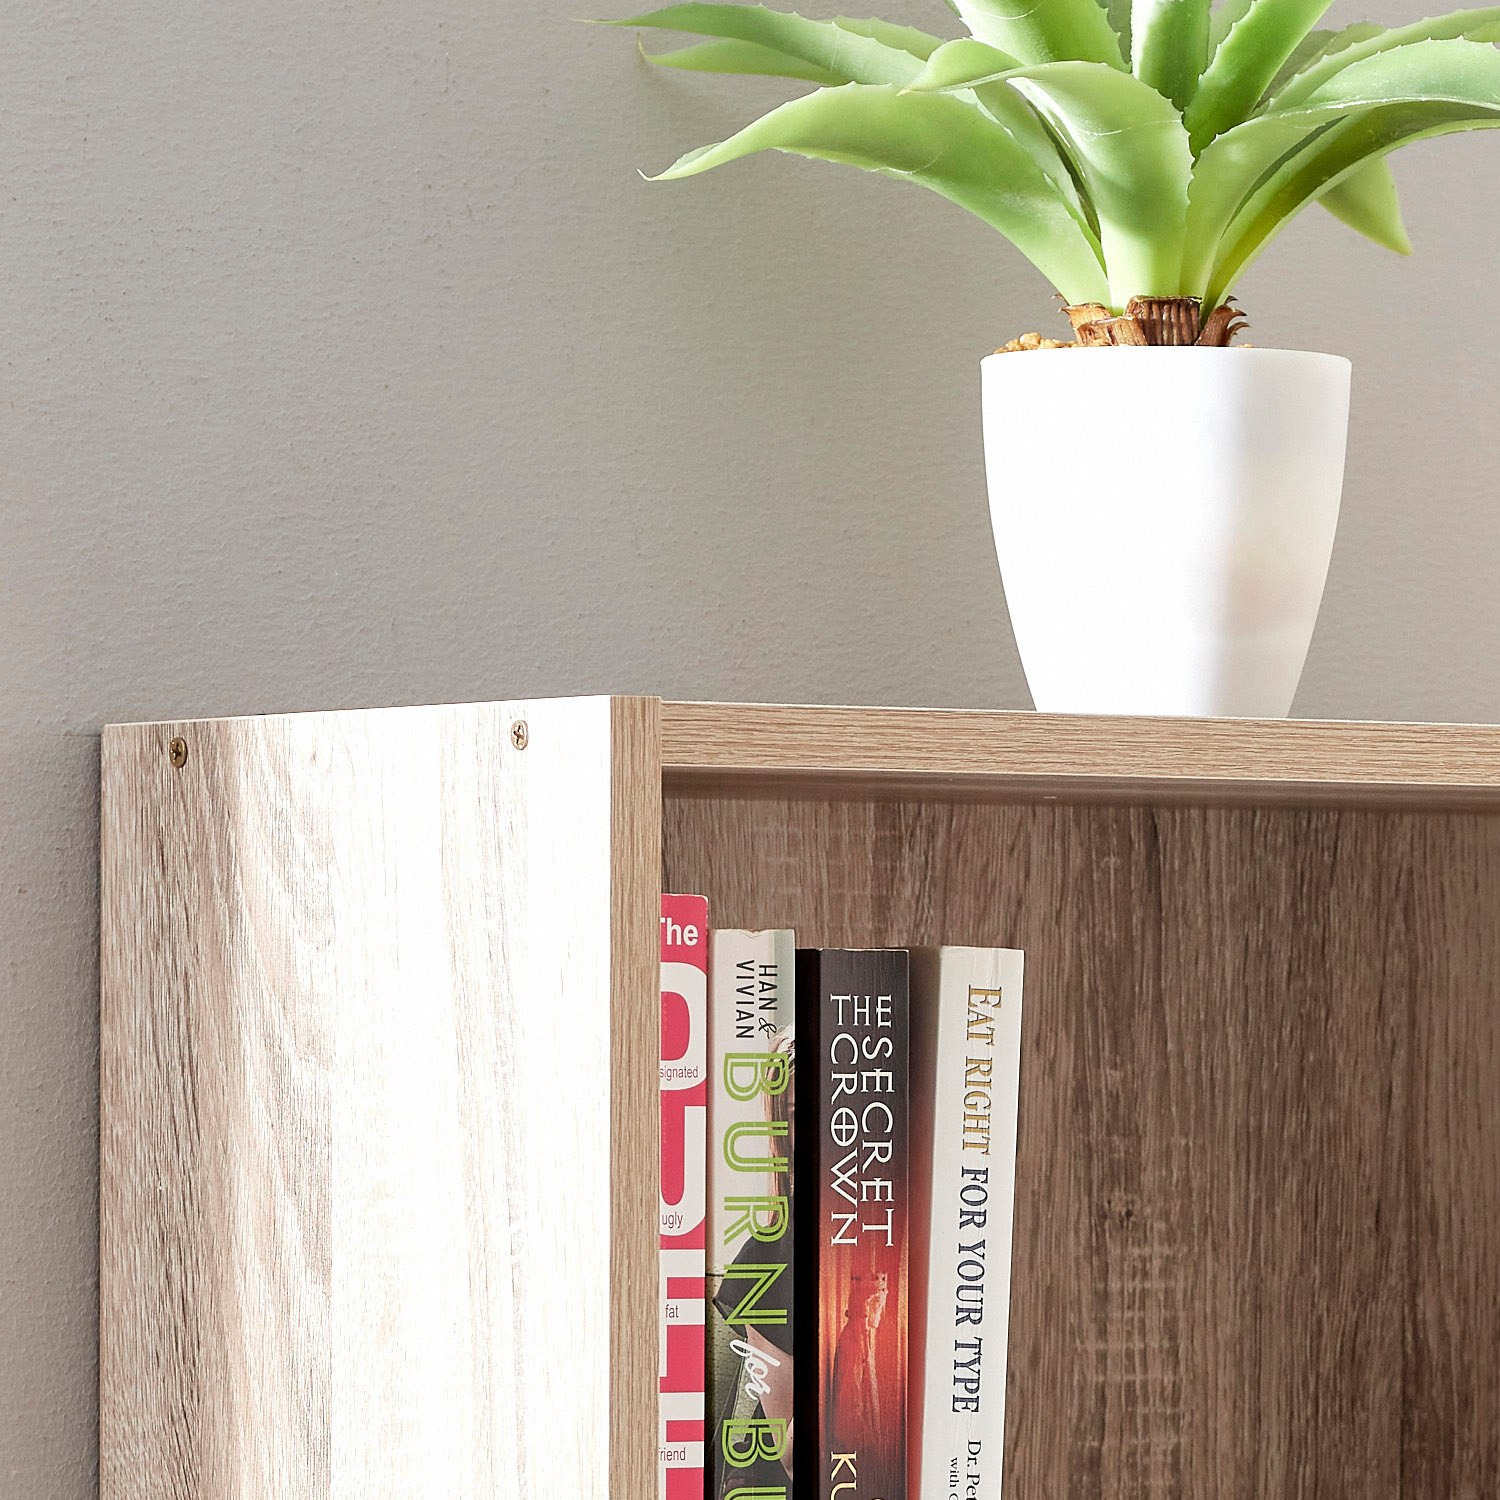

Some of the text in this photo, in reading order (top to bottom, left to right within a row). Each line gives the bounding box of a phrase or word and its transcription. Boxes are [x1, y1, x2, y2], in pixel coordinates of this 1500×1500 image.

[660, 917, 699, 946] he
[735, 959, 755, 1039] VIVIAN
[758, 964, 778, 1040] HAN &
[830, 993, 892, 1028] THE
[660, 1065, 699, 1081] signated
[830, 1032, 858, 1246] CROWN
[861, 1035, 894, 1247] SECRET
[722, 1052, 789, 1325] BURN
[951, 984, 1002, 1414] EAT RIGHT FOR YOUR TYPE
[661, 1211, 683, 1228] ugly
[665, 1304, 679, 1319] fat
[730, 1339, 781, 1400] for
[659, 1446, 686, 1461] riend
[966, 1439, 981, 1467] Dr.
[949, 1457, 960, 1488] with
